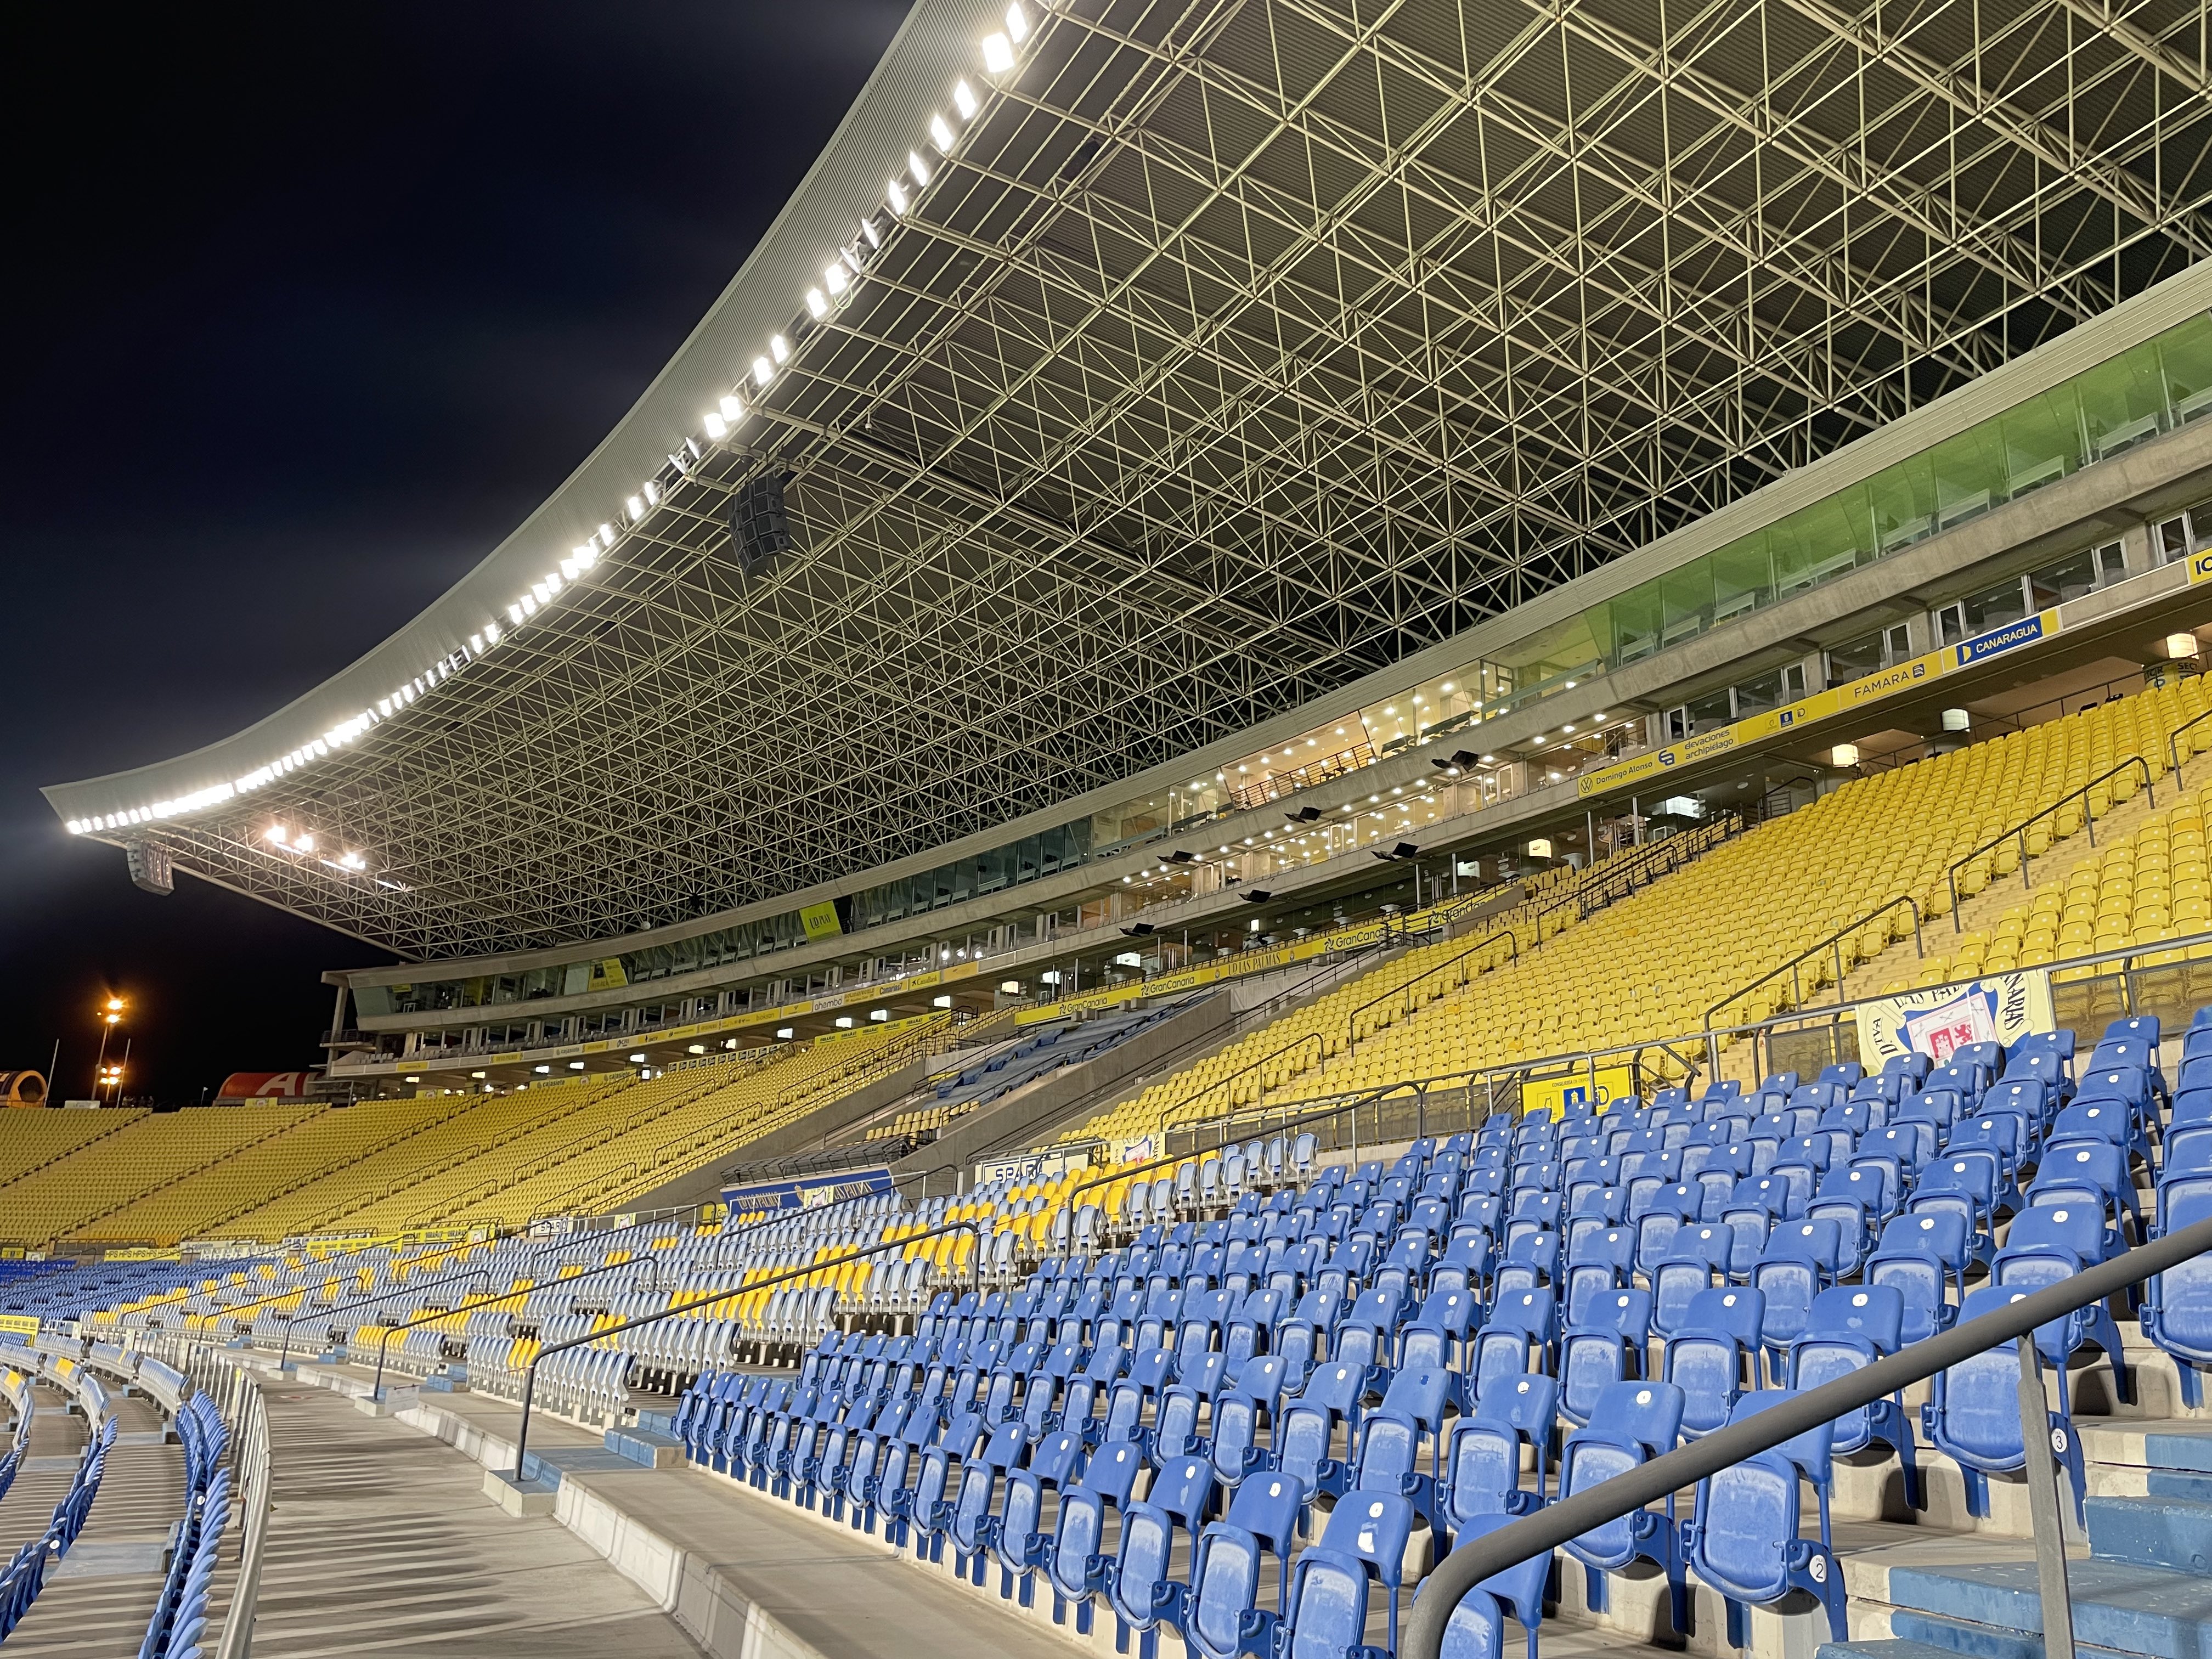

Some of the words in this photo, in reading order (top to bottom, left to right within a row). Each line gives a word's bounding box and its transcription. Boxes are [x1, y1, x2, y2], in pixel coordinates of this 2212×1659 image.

[1976, 624, 2038, 653] CANARAGUA
[1854, 671, 1910, 698] FAMARA
[1684, 729, 1730, 750] elevaciones
[1685, 738, 1734, 759] archipiélago
[1596, 770, 1627, 785] Domingo
[1628, 761, 1652, 774] Alonso
[1228, 962, 1238, 976] UD
[1239, 959, 1251, 973] LAS
[1253, 952, 1280, 970] PALMAS
[879, 982, 903, 995] Canarias7
[917, 975, 937, 985] CaixaBank
[1150, 975, 1194, 994] GranCanaria
[1067, 996, 1107, 1012] GranCanaria
[133, 1250, 146, 1258] HPS
[2056, 1435, 2063, 1449] 3
[1816, 1563, 1824, 1579] 2
